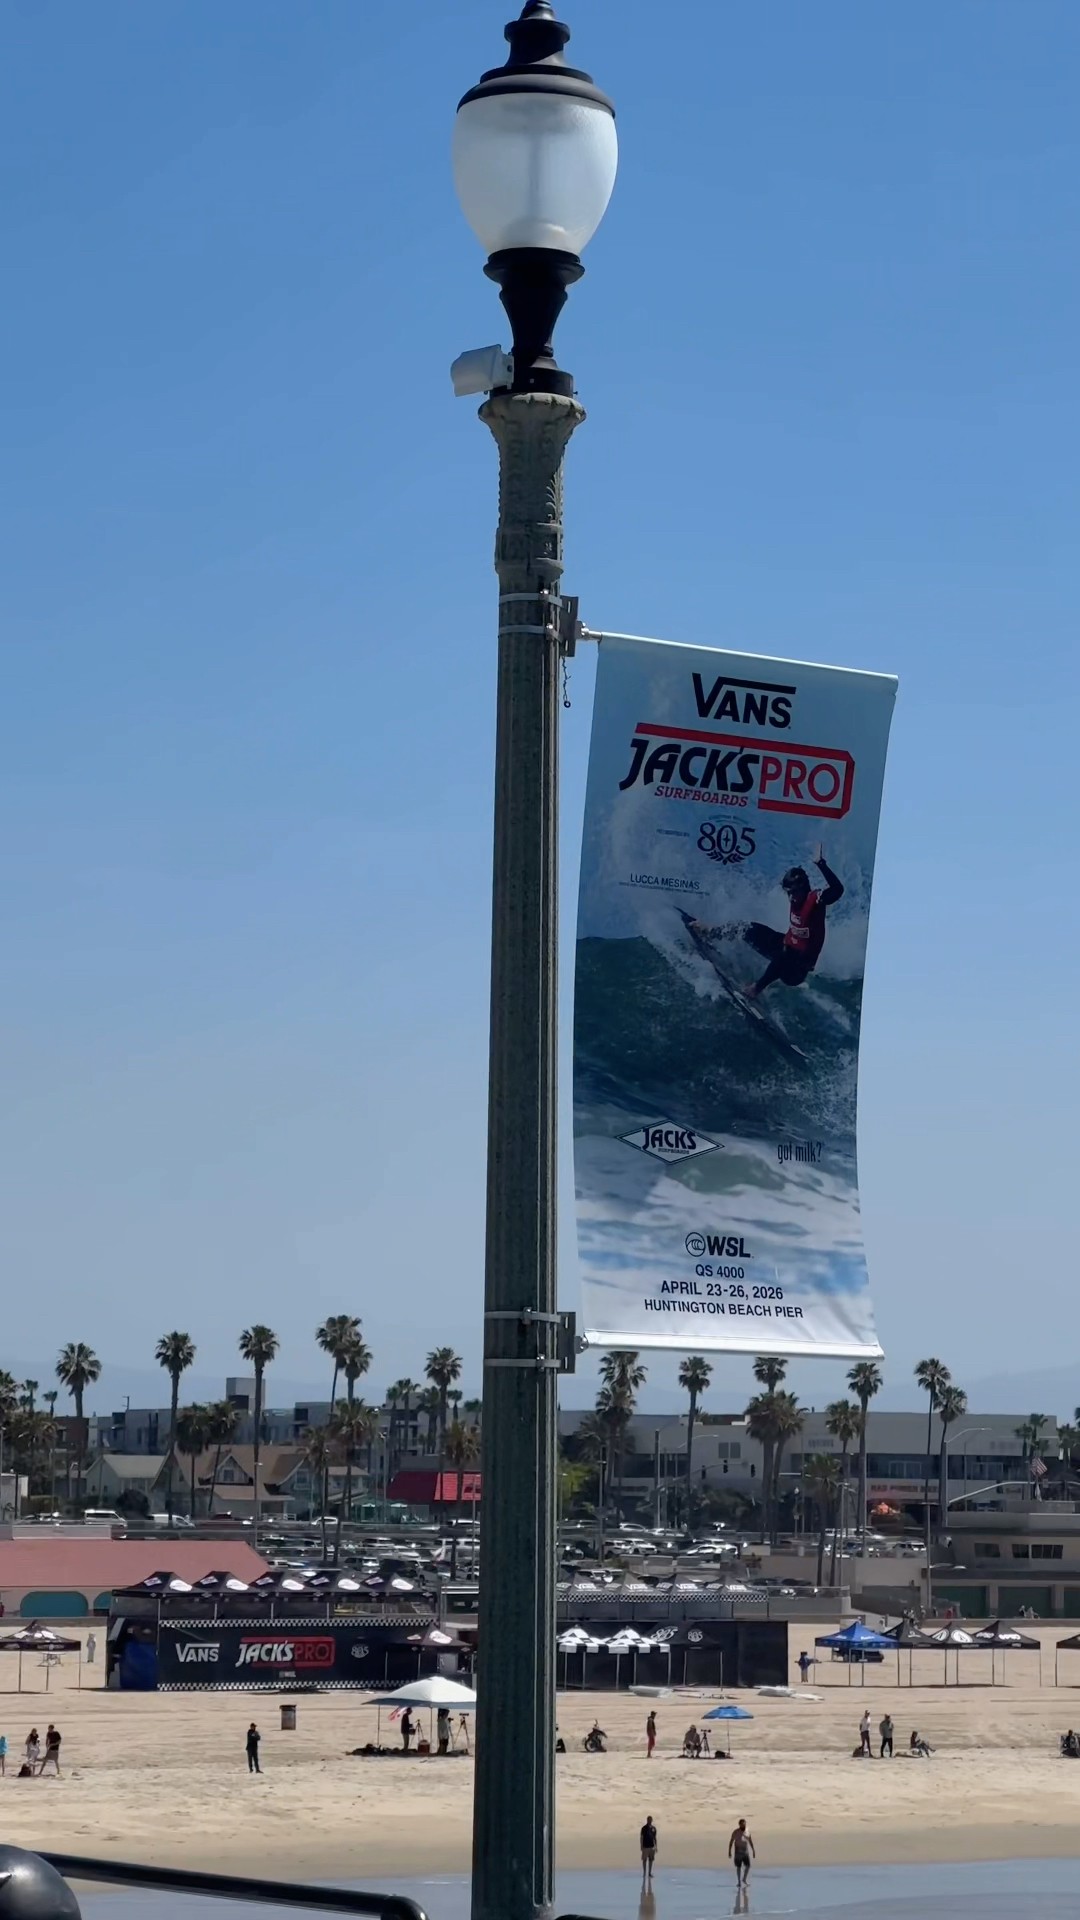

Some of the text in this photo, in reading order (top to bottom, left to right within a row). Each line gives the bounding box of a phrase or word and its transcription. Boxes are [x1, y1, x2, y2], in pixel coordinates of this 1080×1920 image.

[691, 672, 797, 729] VANS
[619, 738, 841, 803] JACK'S PRO
[654, 785, 748, 807] SURFBOARDS
[697, 822, 756, 857] 805
[630, 873, 659, 886] LUCCA
[661, 877, 700, 890] MESINAS
[778, 1141, 822, 1165] got milk?
[707, 1235, 751, 1258] WSL
[695, 1264, 745, 1279] QS 4000
[661, 1280, 784, 1300] APRIL 23-26, 2026
[644, 1299, 804, 1318] HUNTINGTON BEACH PIER
[175, 1643, 220, 1662] VANS
[235, 1640, 330, 1668] JACK'S PRO
